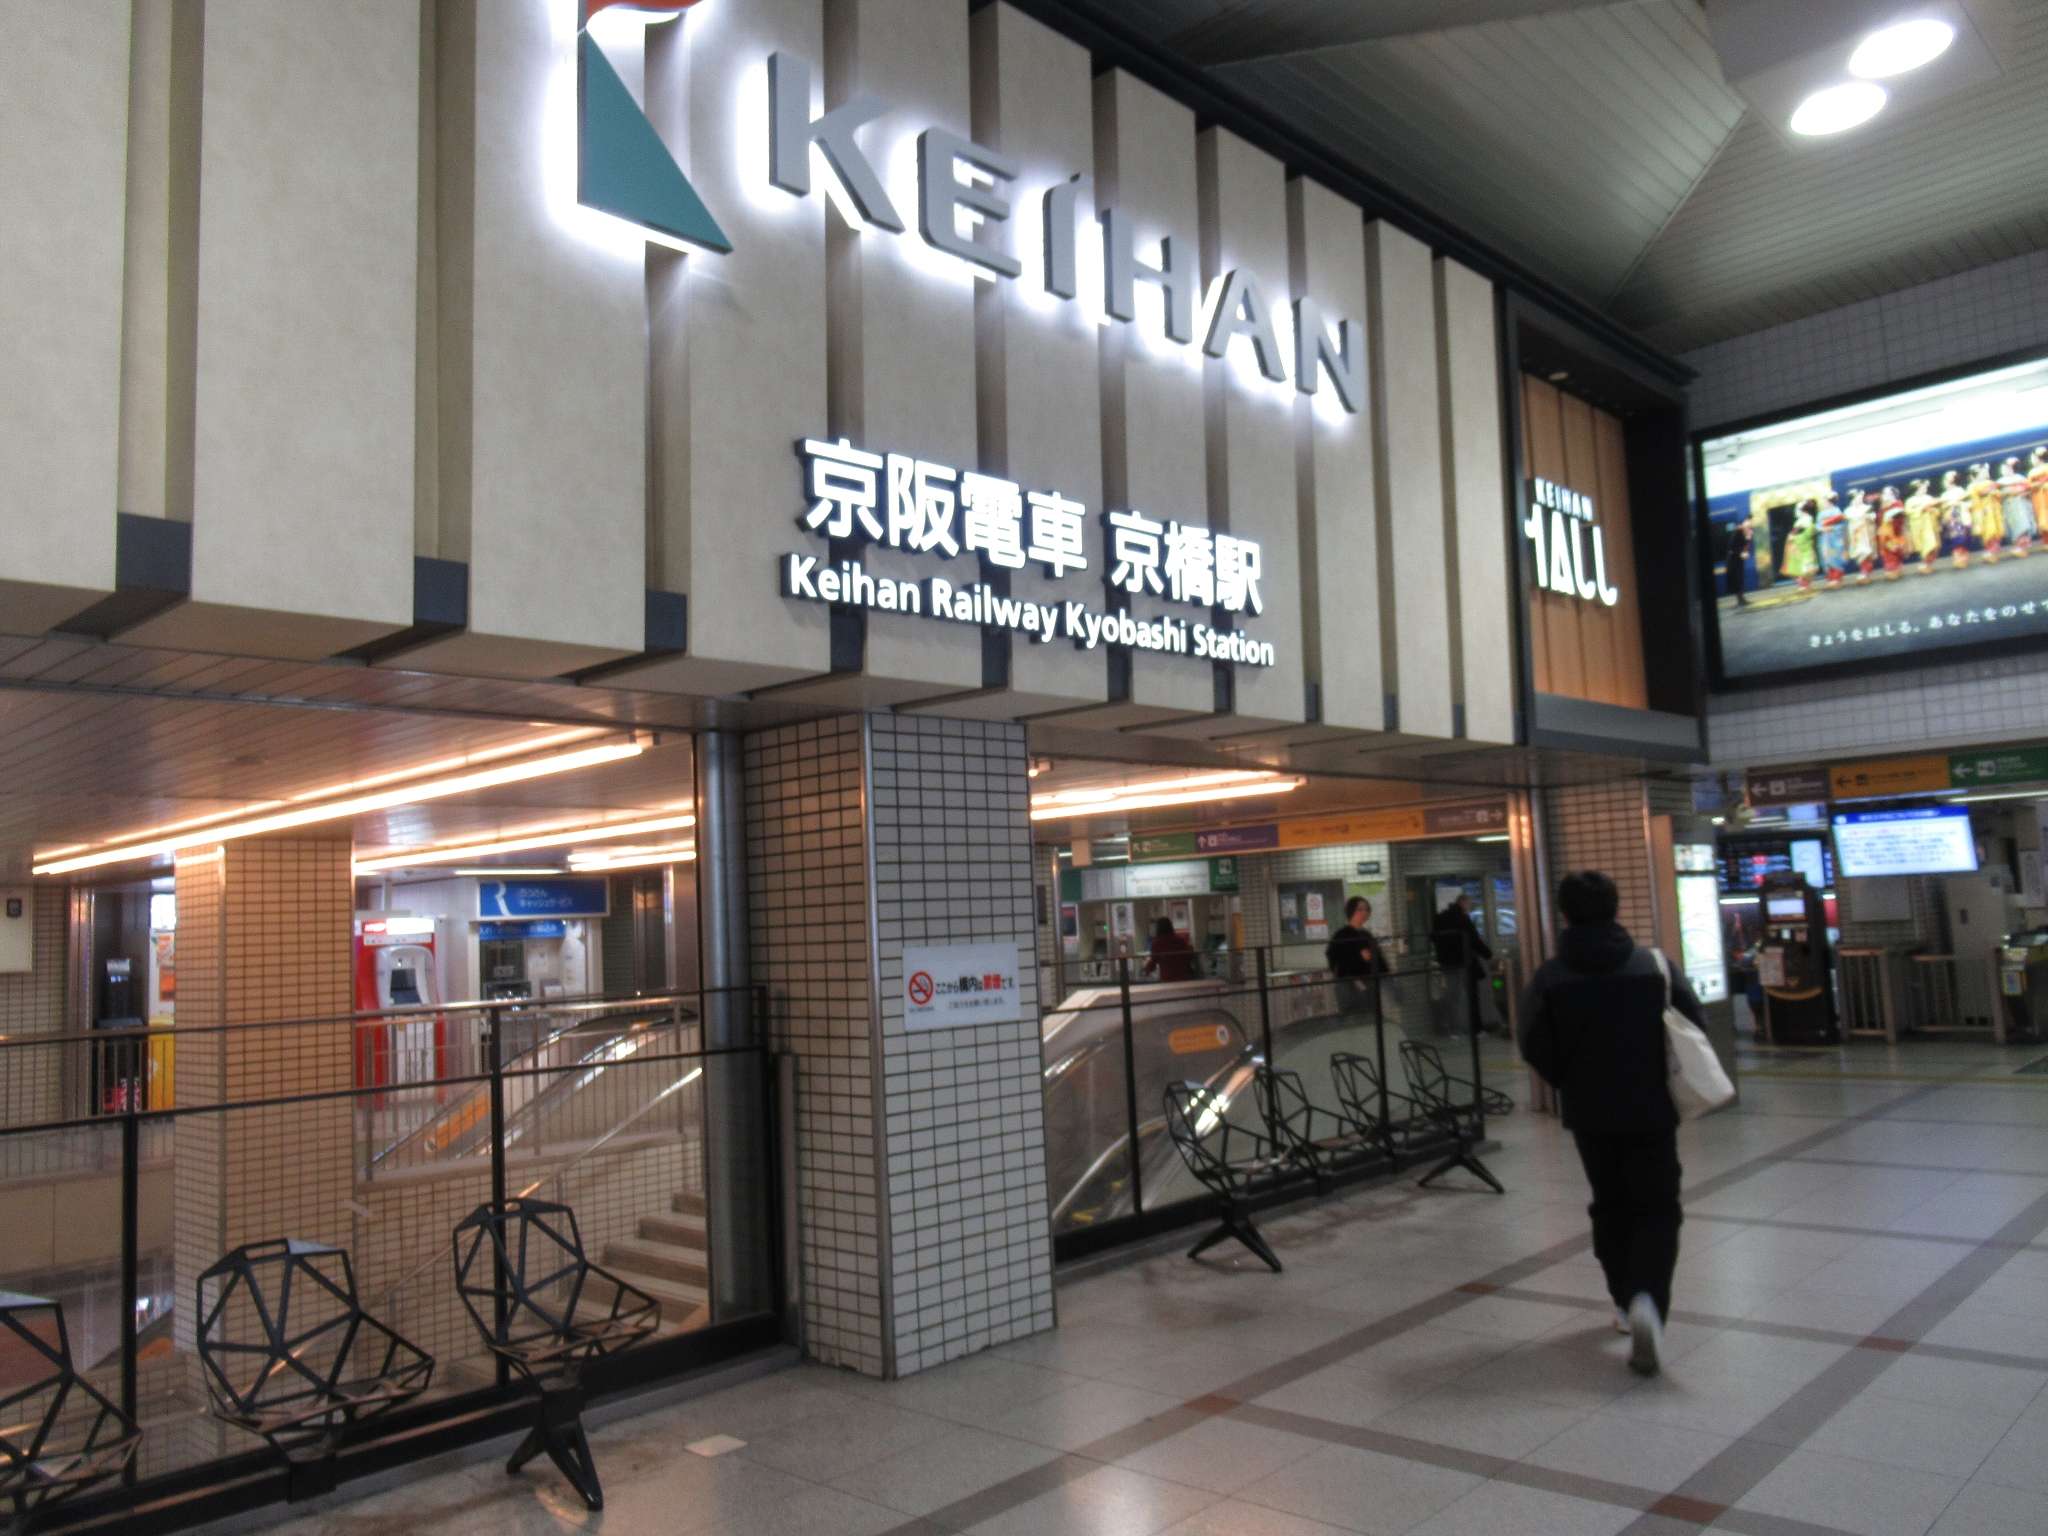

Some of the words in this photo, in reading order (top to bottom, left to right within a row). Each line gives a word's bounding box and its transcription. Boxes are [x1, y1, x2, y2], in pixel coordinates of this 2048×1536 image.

[768, 50, 1364, 414] KEIHAN
[790, 553, 921, 614] Keihan
[931, 577, 1058, 643] Railway
[1065, 600, 1187, 653] Kyobashi
[1193, 623, 1275, 666] Station
[804, 438, 1088, 578] 京阪電車
[1109, 510, 1263, 615] 京橋駅
